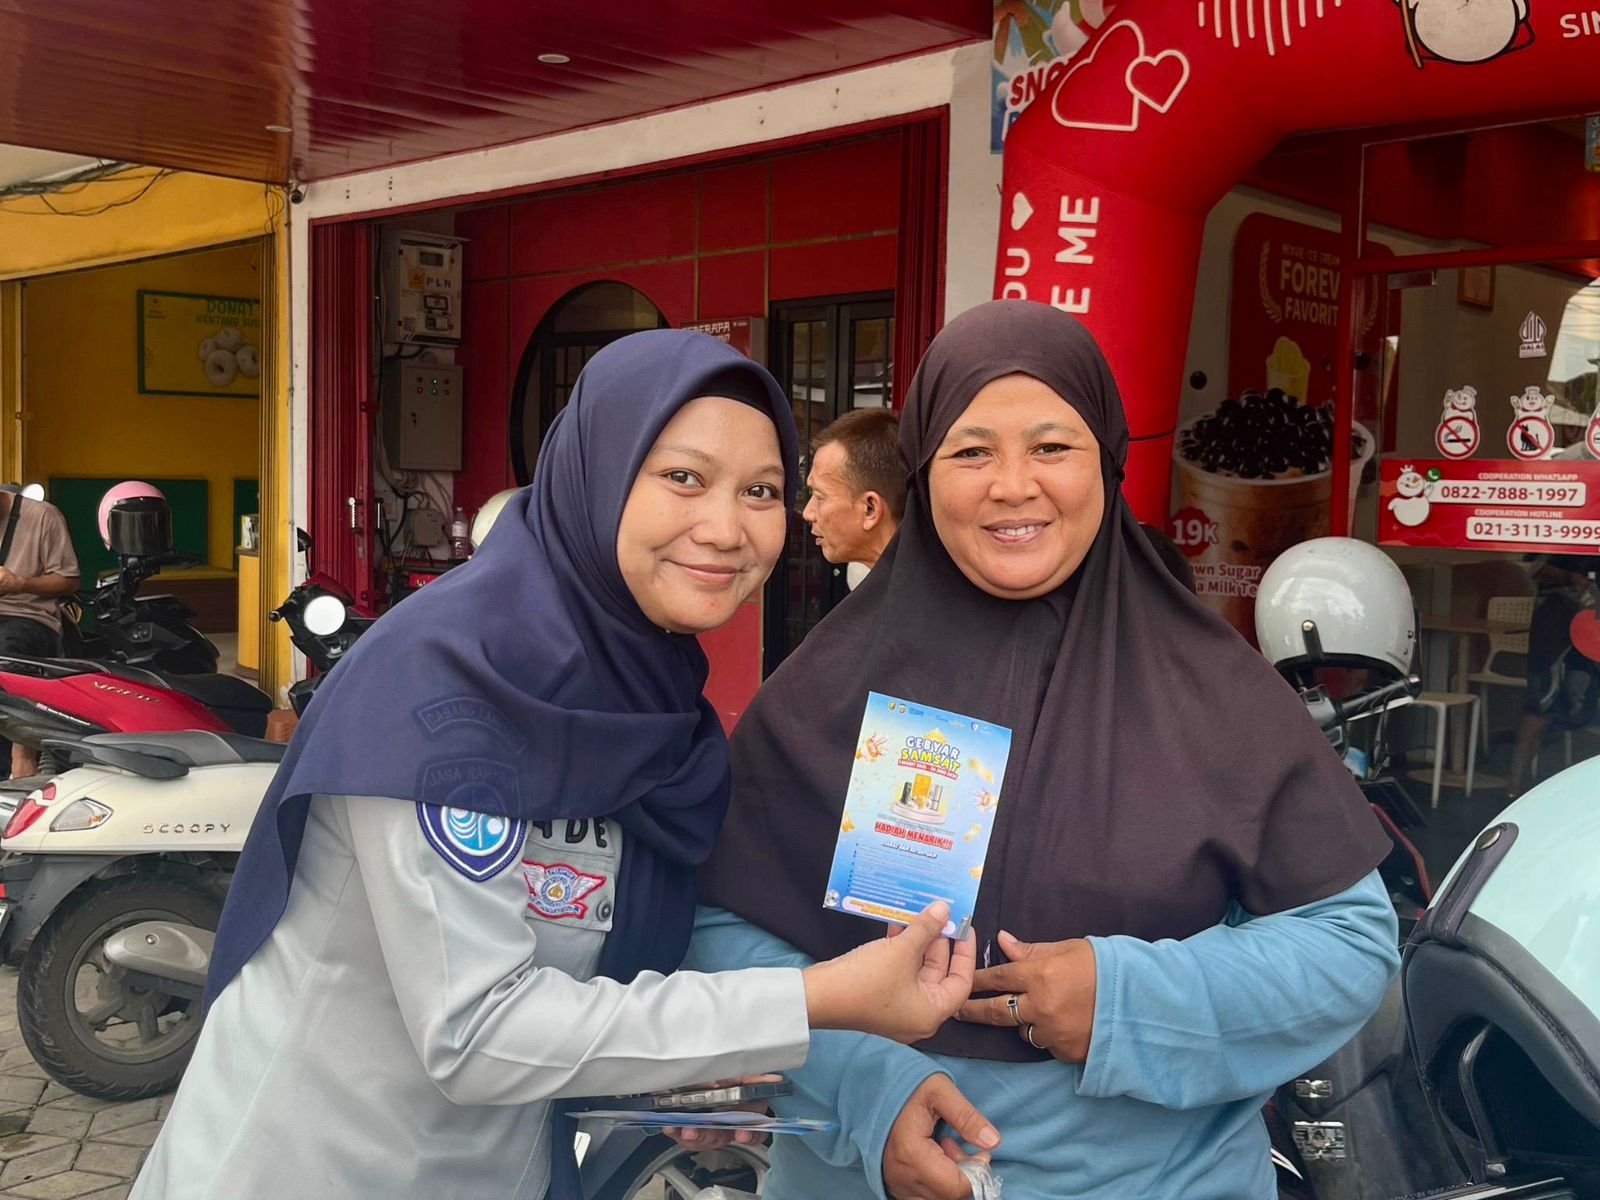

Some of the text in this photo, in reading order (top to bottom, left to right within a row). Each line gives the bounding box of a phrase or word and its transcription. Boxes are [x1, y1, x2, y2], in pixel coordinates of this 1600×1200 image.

[1055, 195, 1100, 264] ME
[426, 276, 451, 288] PLN
[1280, 259, 1341, 300] FOREV
[1284, 296, 1339, 327] FAVORIT
[1478, 472, 1578, 481] COOPERATION WHATSAPP
[1441, 486, 1578, 501] 0822-7888-1997
[1474, 508, 1563, 518] COOPERATION HOTLINE
[1172, 519, 1219, 546] 19K
[1473, 522, 1600, 539] 021-3113-9999
[1219, 564, 1260, 580] Sugar
[1208, 580, 1237, 594] Milk
[906, 736, 960, 761] GEBYAR
[901, 748, 961, 773] SAMSAT
[142, 823, 232, 834] SCOOPY
[874, 821, 906, 838] HADIAH
